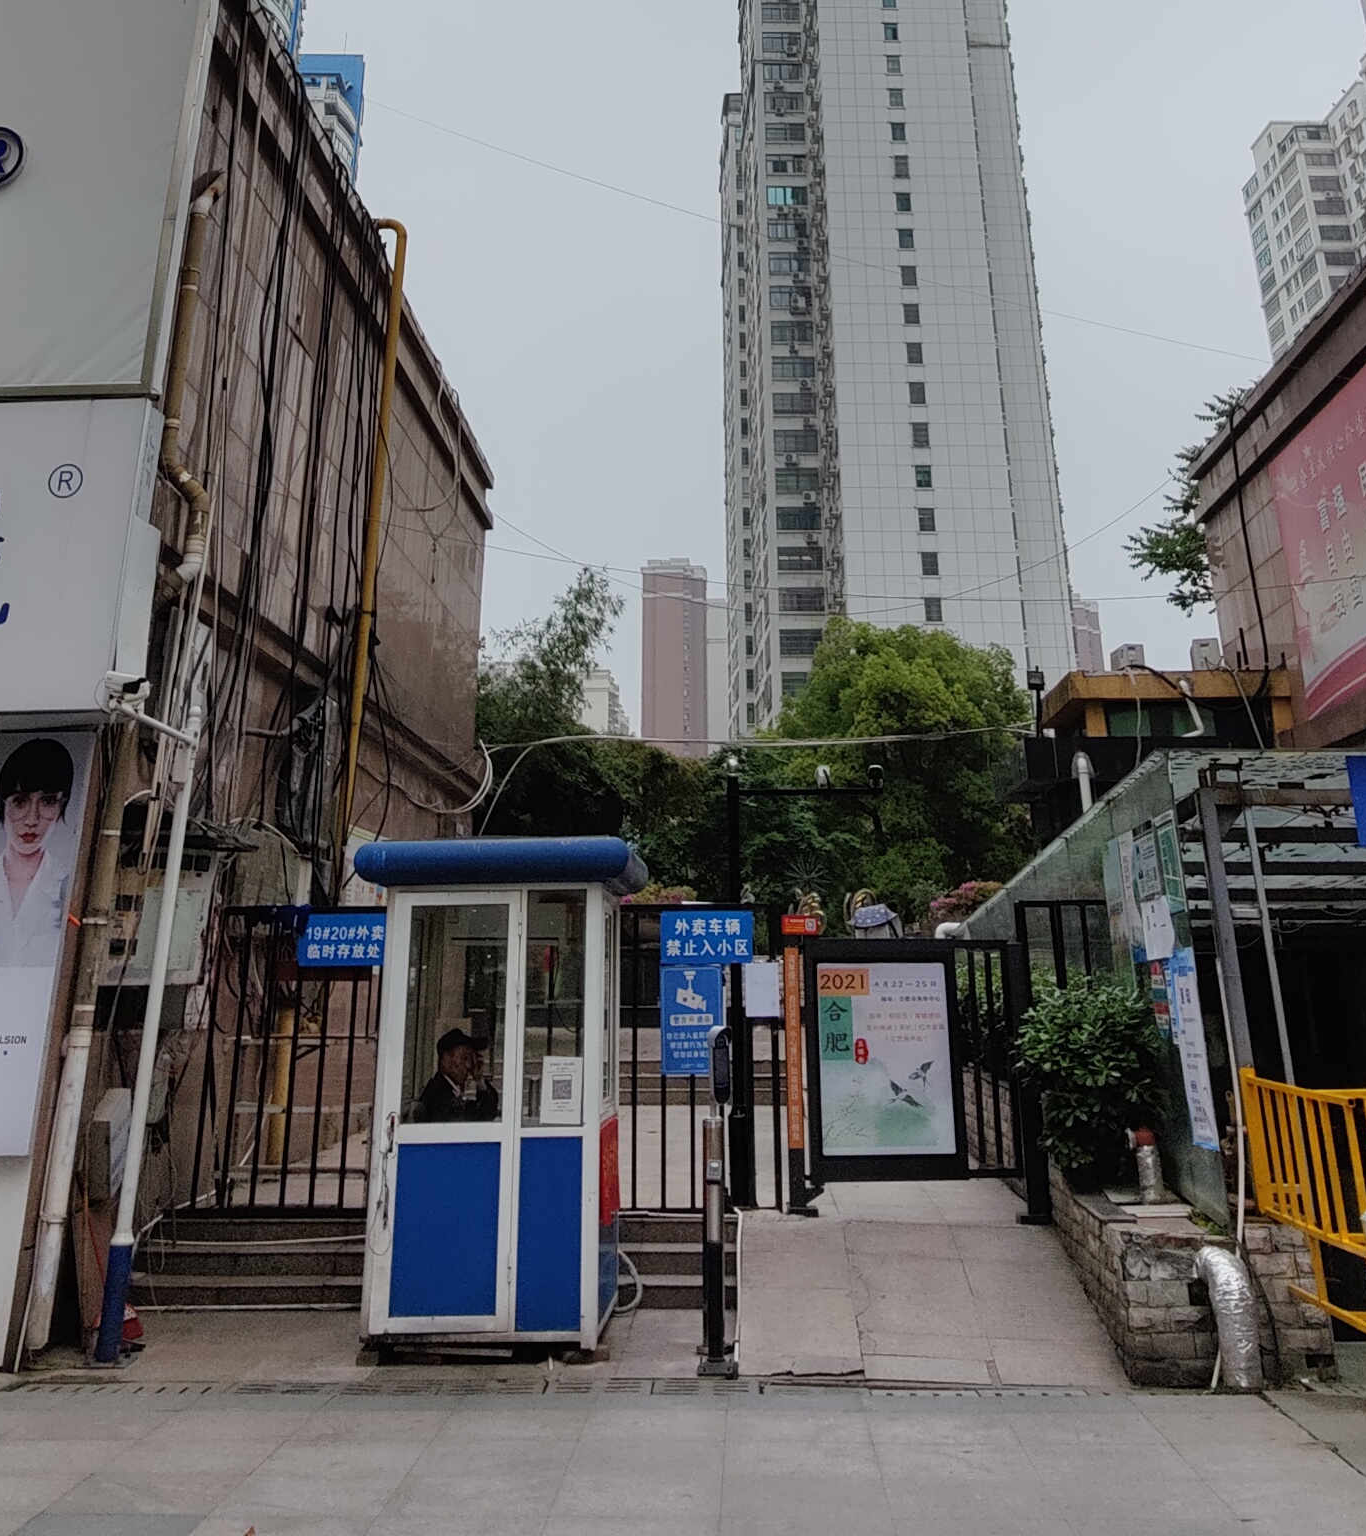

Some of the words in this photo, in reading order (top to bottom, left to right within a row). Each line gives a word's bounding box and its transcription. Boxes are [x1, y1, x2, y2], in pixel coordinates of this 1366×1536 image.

[1317, 483, 1347, 533] 富强
[306, 925, 385, 941] 19#20#外卖
[674, 918, 741, 936] 外卖车辆
[306, 943, 381, 960] 临时存放处
[665, 939, 749, 957] 禁止入小区
[820, 974, 864, 990] 2021
[824, 1000, 851, 1053] 合肥
